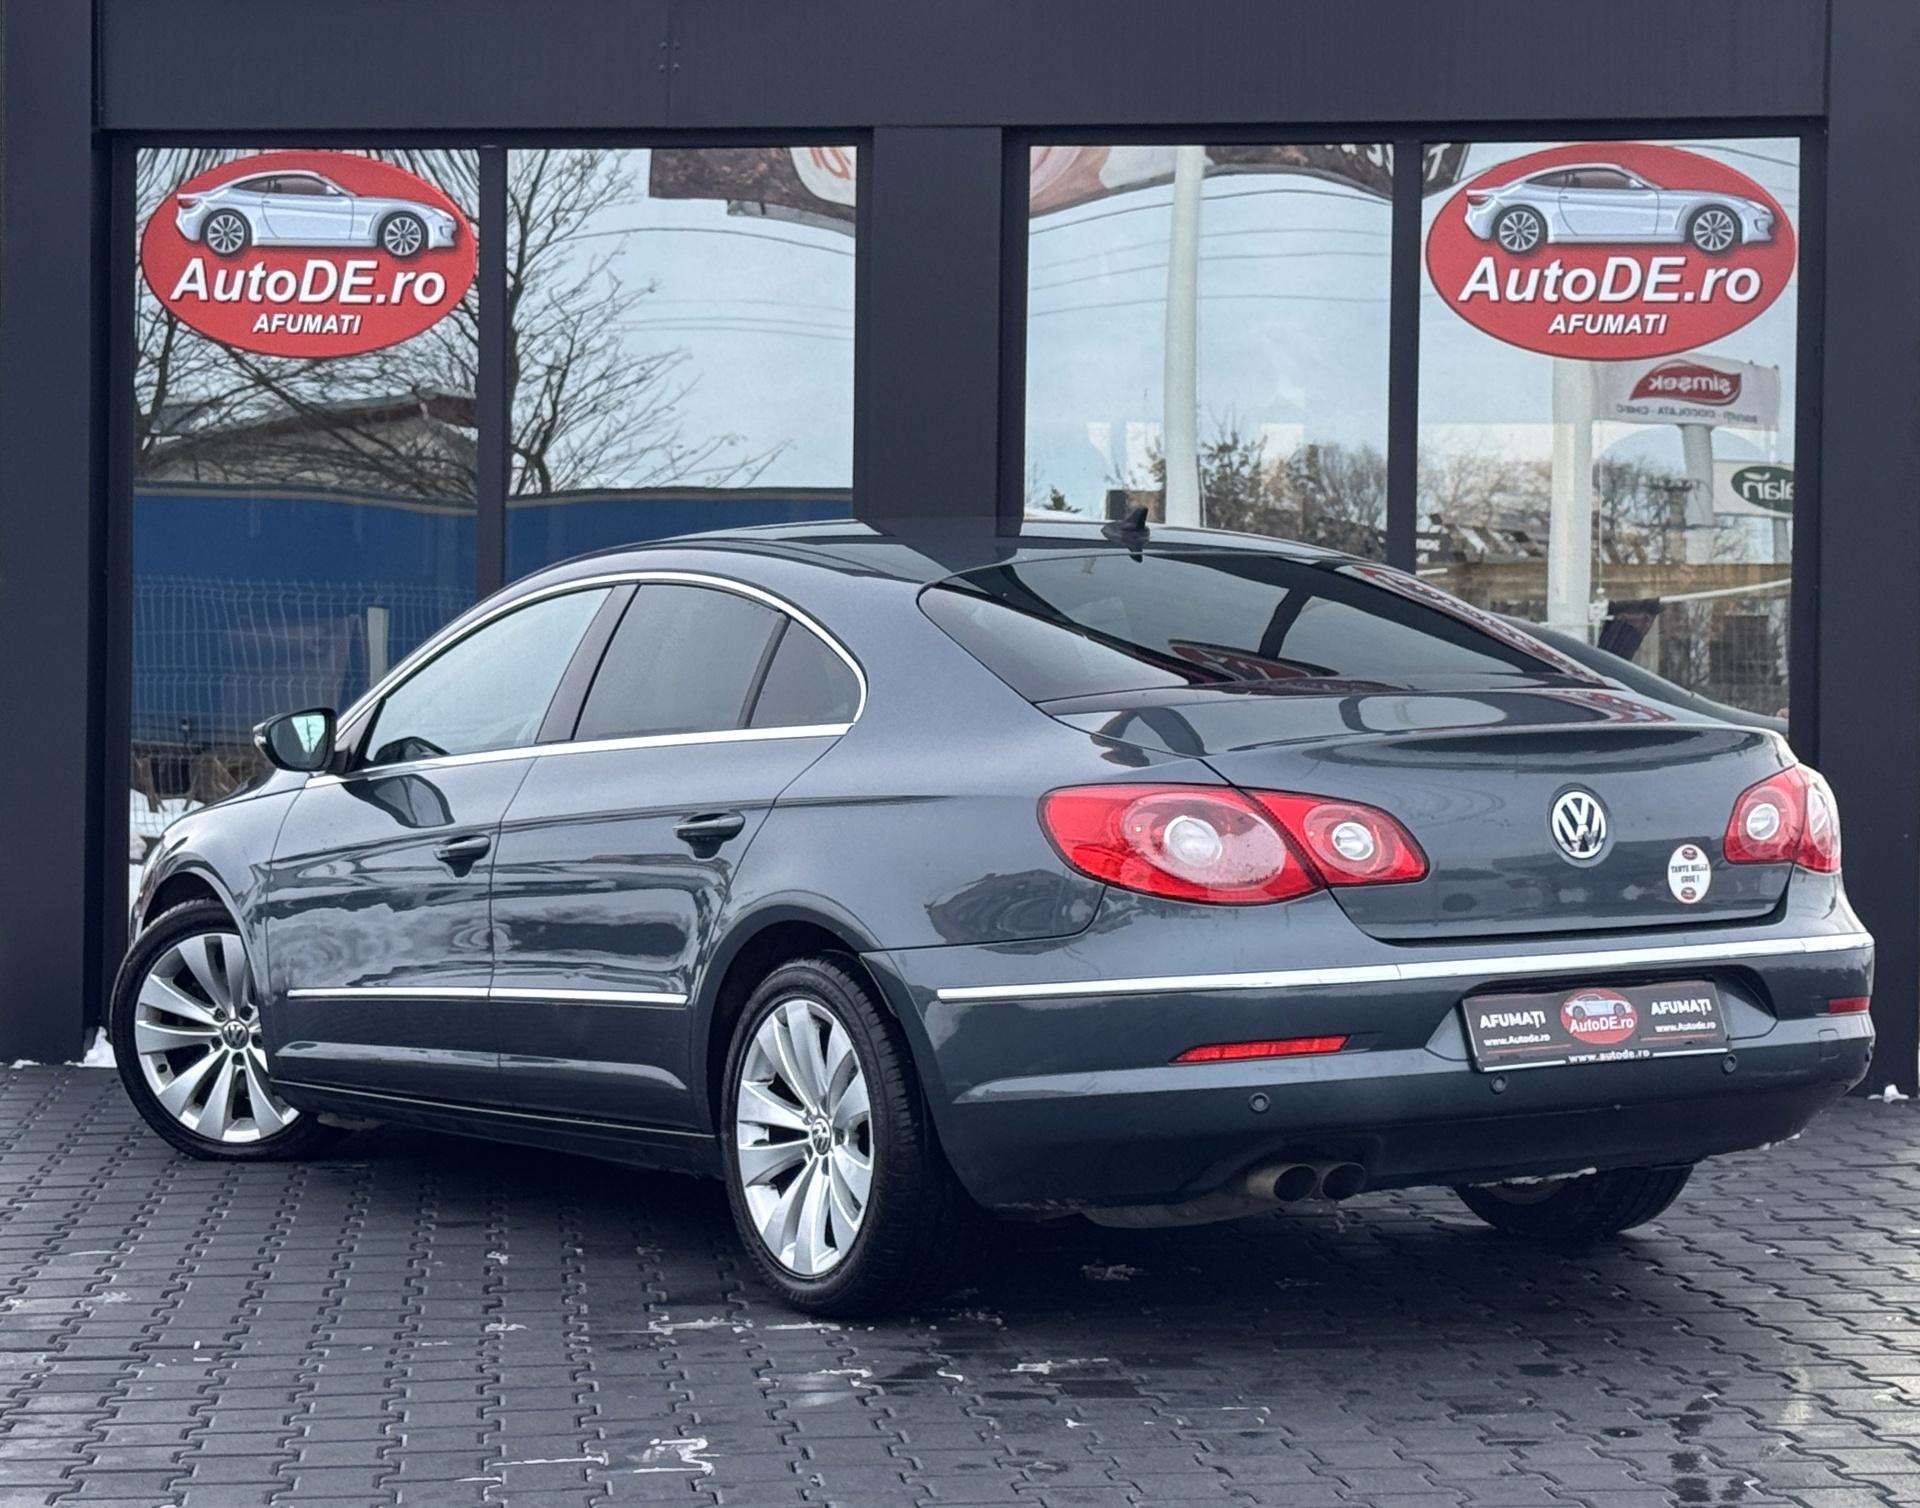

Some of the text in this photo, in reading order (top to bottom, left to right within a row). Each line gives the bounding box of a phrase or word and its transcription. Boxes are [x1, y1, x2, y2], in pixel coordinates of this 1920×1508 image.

[170, 258, 446, 305] AutoDE.ro
[1458, 256, 1761, 303] AutoDE.ro
[252, 313, 363, 335] AFUMATI
[1548, 313, 1668, 335] AFUMATI
[1569, 1016, 1634, 1034] AutoDE.ro
[1568, 1049, 1650, 1063] www.autode.ro
